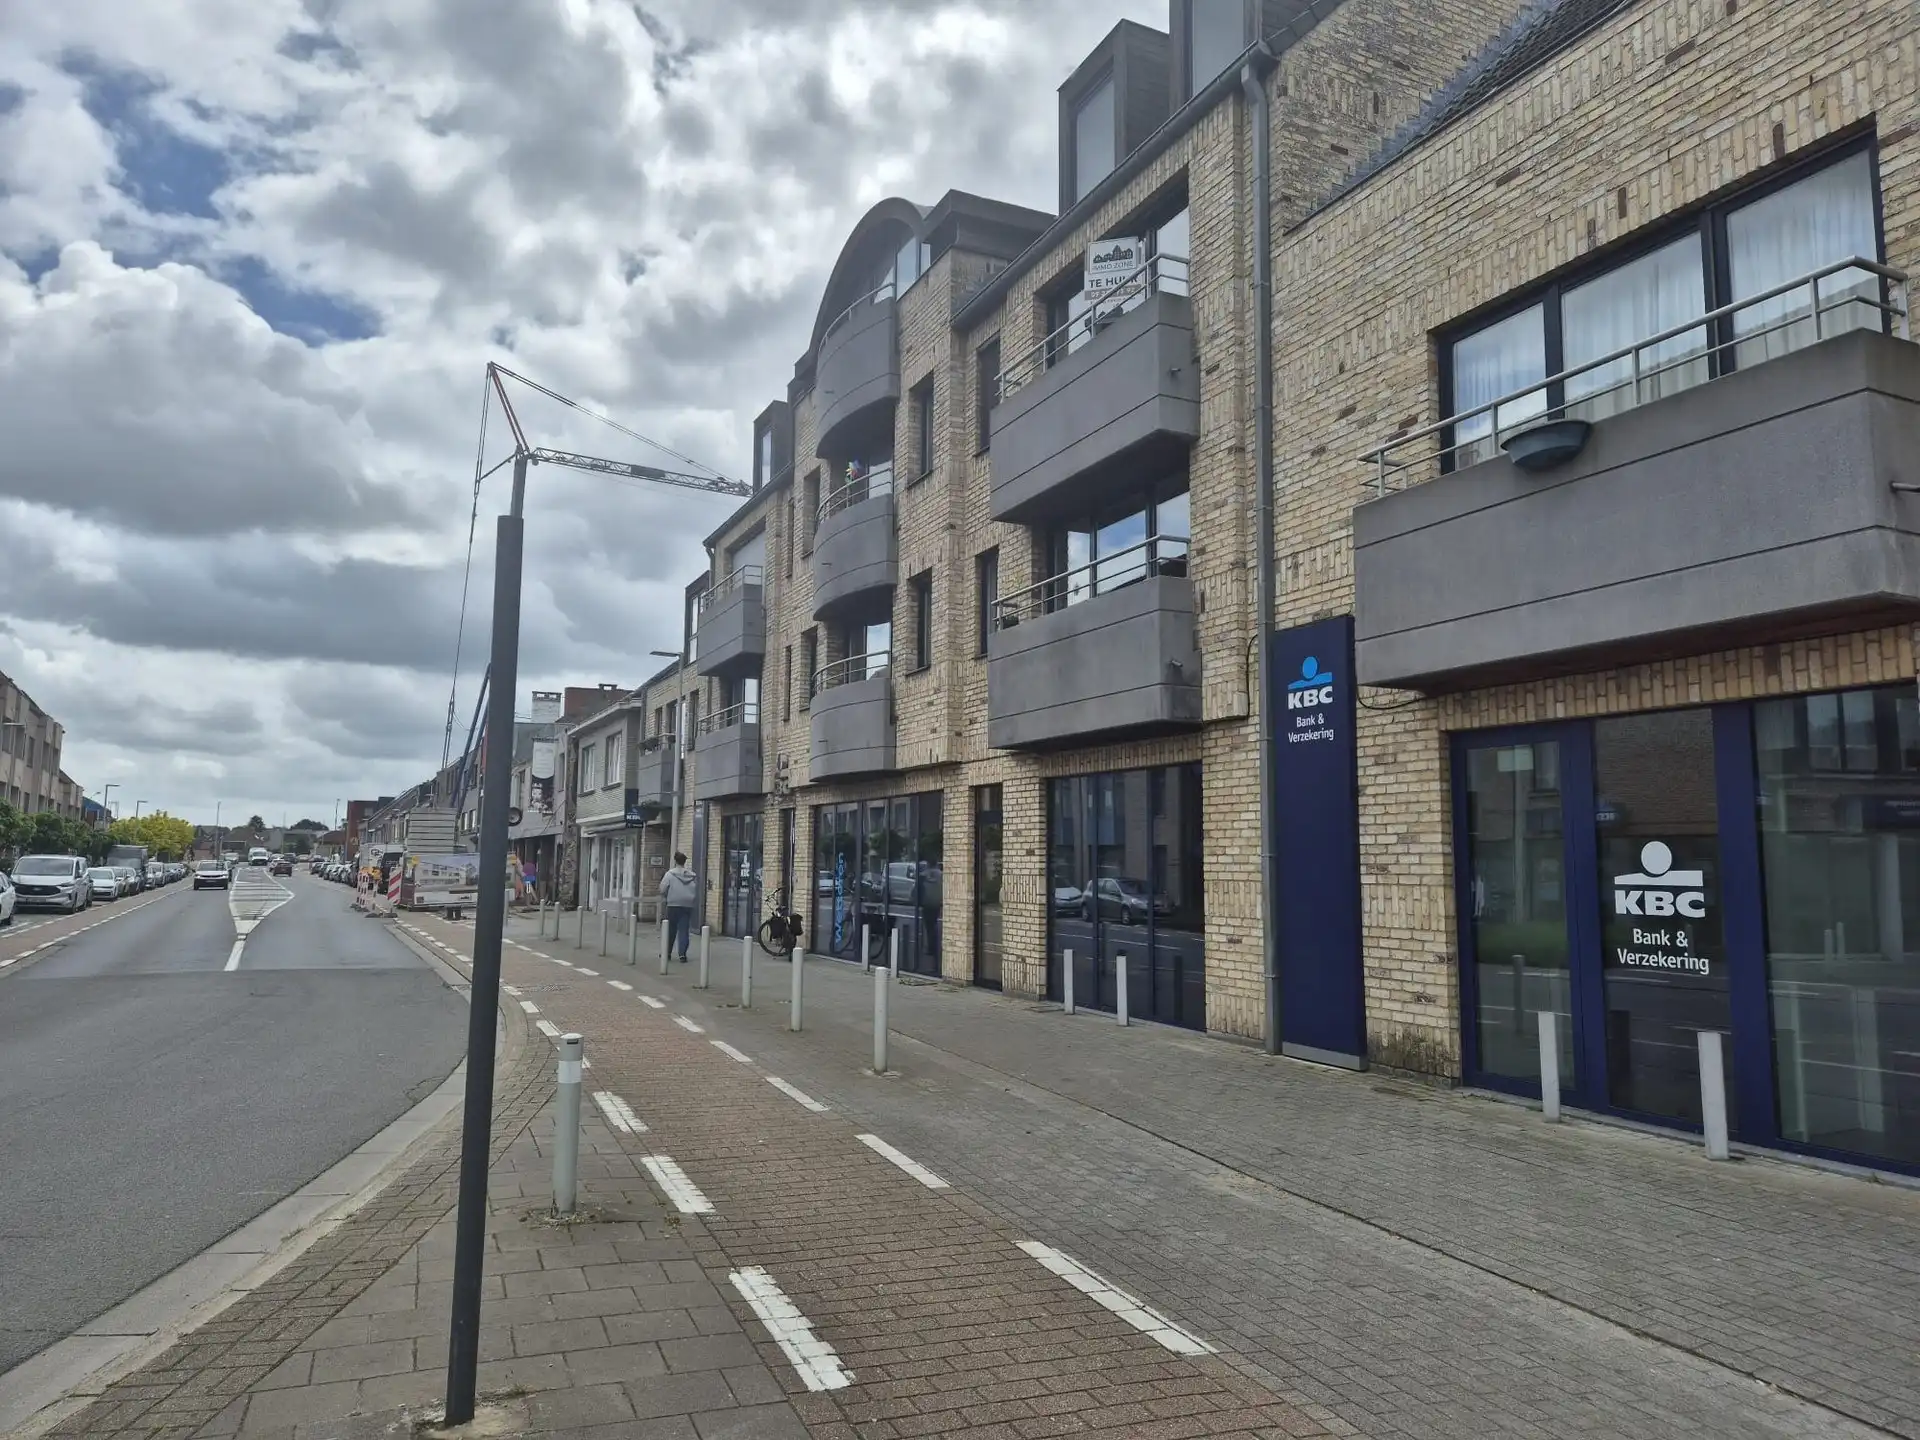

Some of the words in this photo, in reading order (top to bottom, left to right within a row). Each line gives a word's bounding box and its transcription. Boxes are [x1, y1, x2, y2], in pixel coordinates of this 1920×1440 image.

[1113, 261, 1134, 269] ZONE
[1088, 278, 1102, 288] TE
[1105, 275, 1138, 287] HUR
[1287, 685, 1334, 710] KBC
[1296, 714, 1316, 728] Bank
[1317, 712, 1325, 725] &
[1287, 727, 1334, 743] Verzekering
[1614, 889, 1706, 918] KBC
[1633, 928, 1671, 947] Bank
[1675, 930, 1689, 948] &
[1617, 948, 1710, 975] Verzekering
